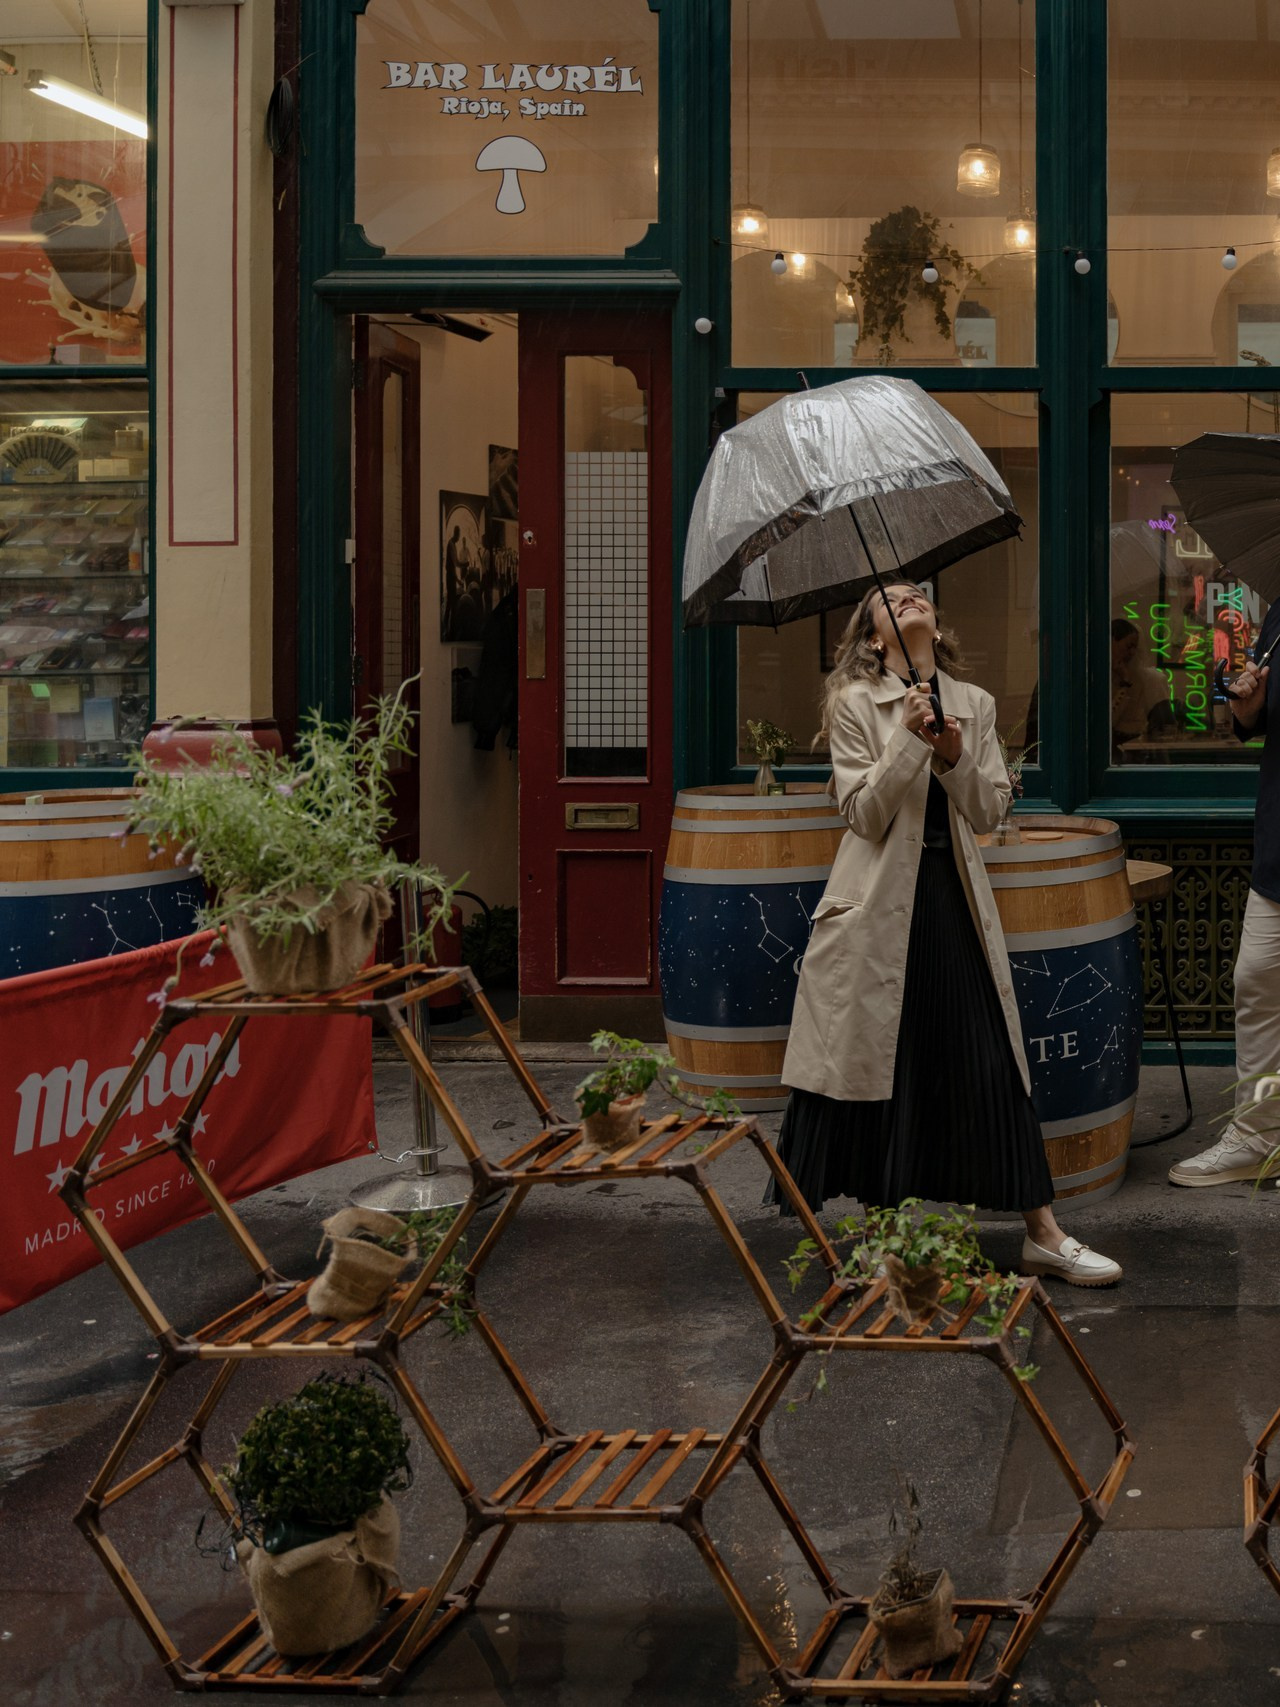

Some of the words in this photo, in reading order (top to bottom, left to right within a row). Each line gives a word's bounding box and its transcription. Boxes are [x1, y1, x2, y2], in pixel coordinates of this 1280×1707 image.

[381, 61, 468, 91] BAR
[477, 57, 643, 96] LAURÉL
[440, 96, 510, 121] Rioja,
[518, 96, 588, 120] Spain
[1207, 583, 1271, 624] PIN
[1030, 1031, 1079, 1063] TE
[25, 1207, 105, 1255] MADRD
[115, 1180, 170, 1219] SINCE
[179, 1159, 216, 1189] 180
